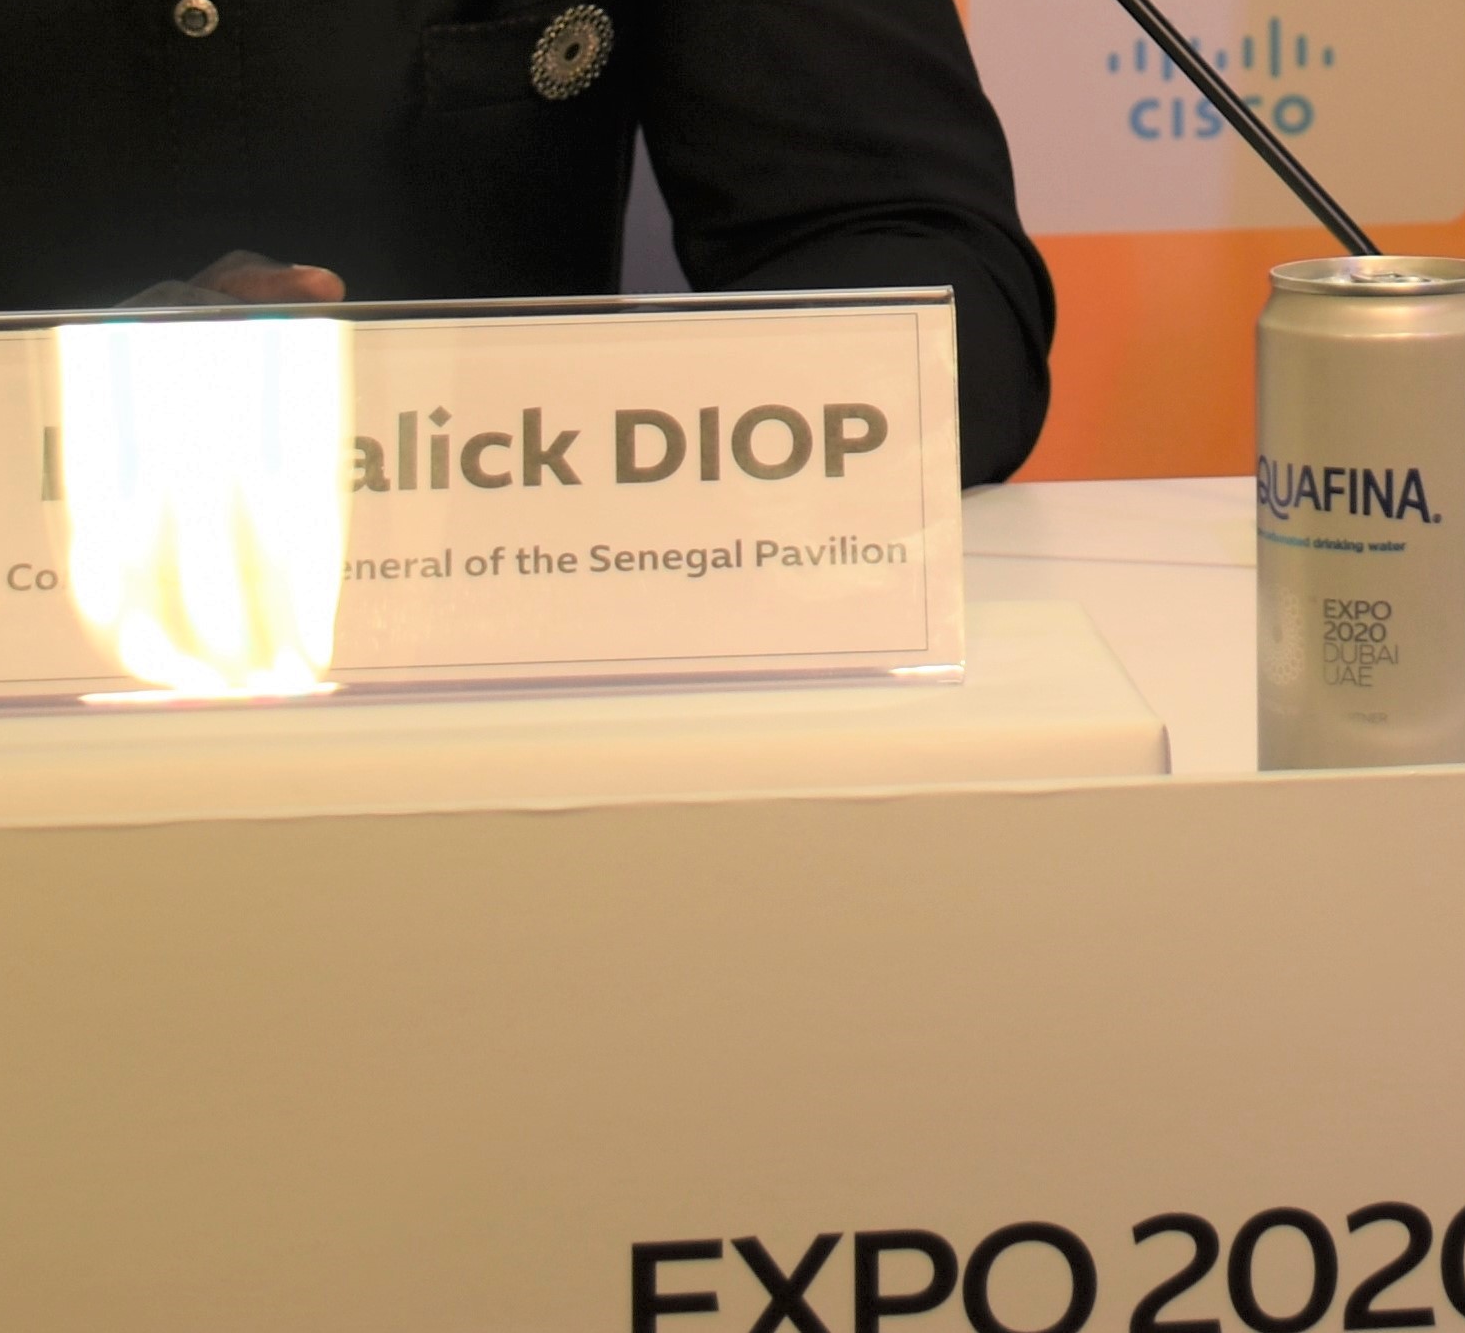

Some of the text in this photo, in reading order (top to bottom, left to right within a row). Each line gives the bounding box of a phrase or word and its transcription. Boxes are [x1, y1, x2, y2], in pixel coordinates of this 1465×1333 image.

[1129, 93, 1315, 140] CISO
[347, 404, 887, 494] alick DIOP
[1258, 454, 1430, 523] QUAFINA
[342, 534, 907, 584] eneral of the Senegal Pavilion
[1323, 598, 1392, 621] EXPO
[1323, 622, 1387, 643] 2020
[1323, 644, 1399, 665] DUBAI
[1323, 666, 1374, 687] UAE
[632, 1222, 1097, 1333] EXPO
